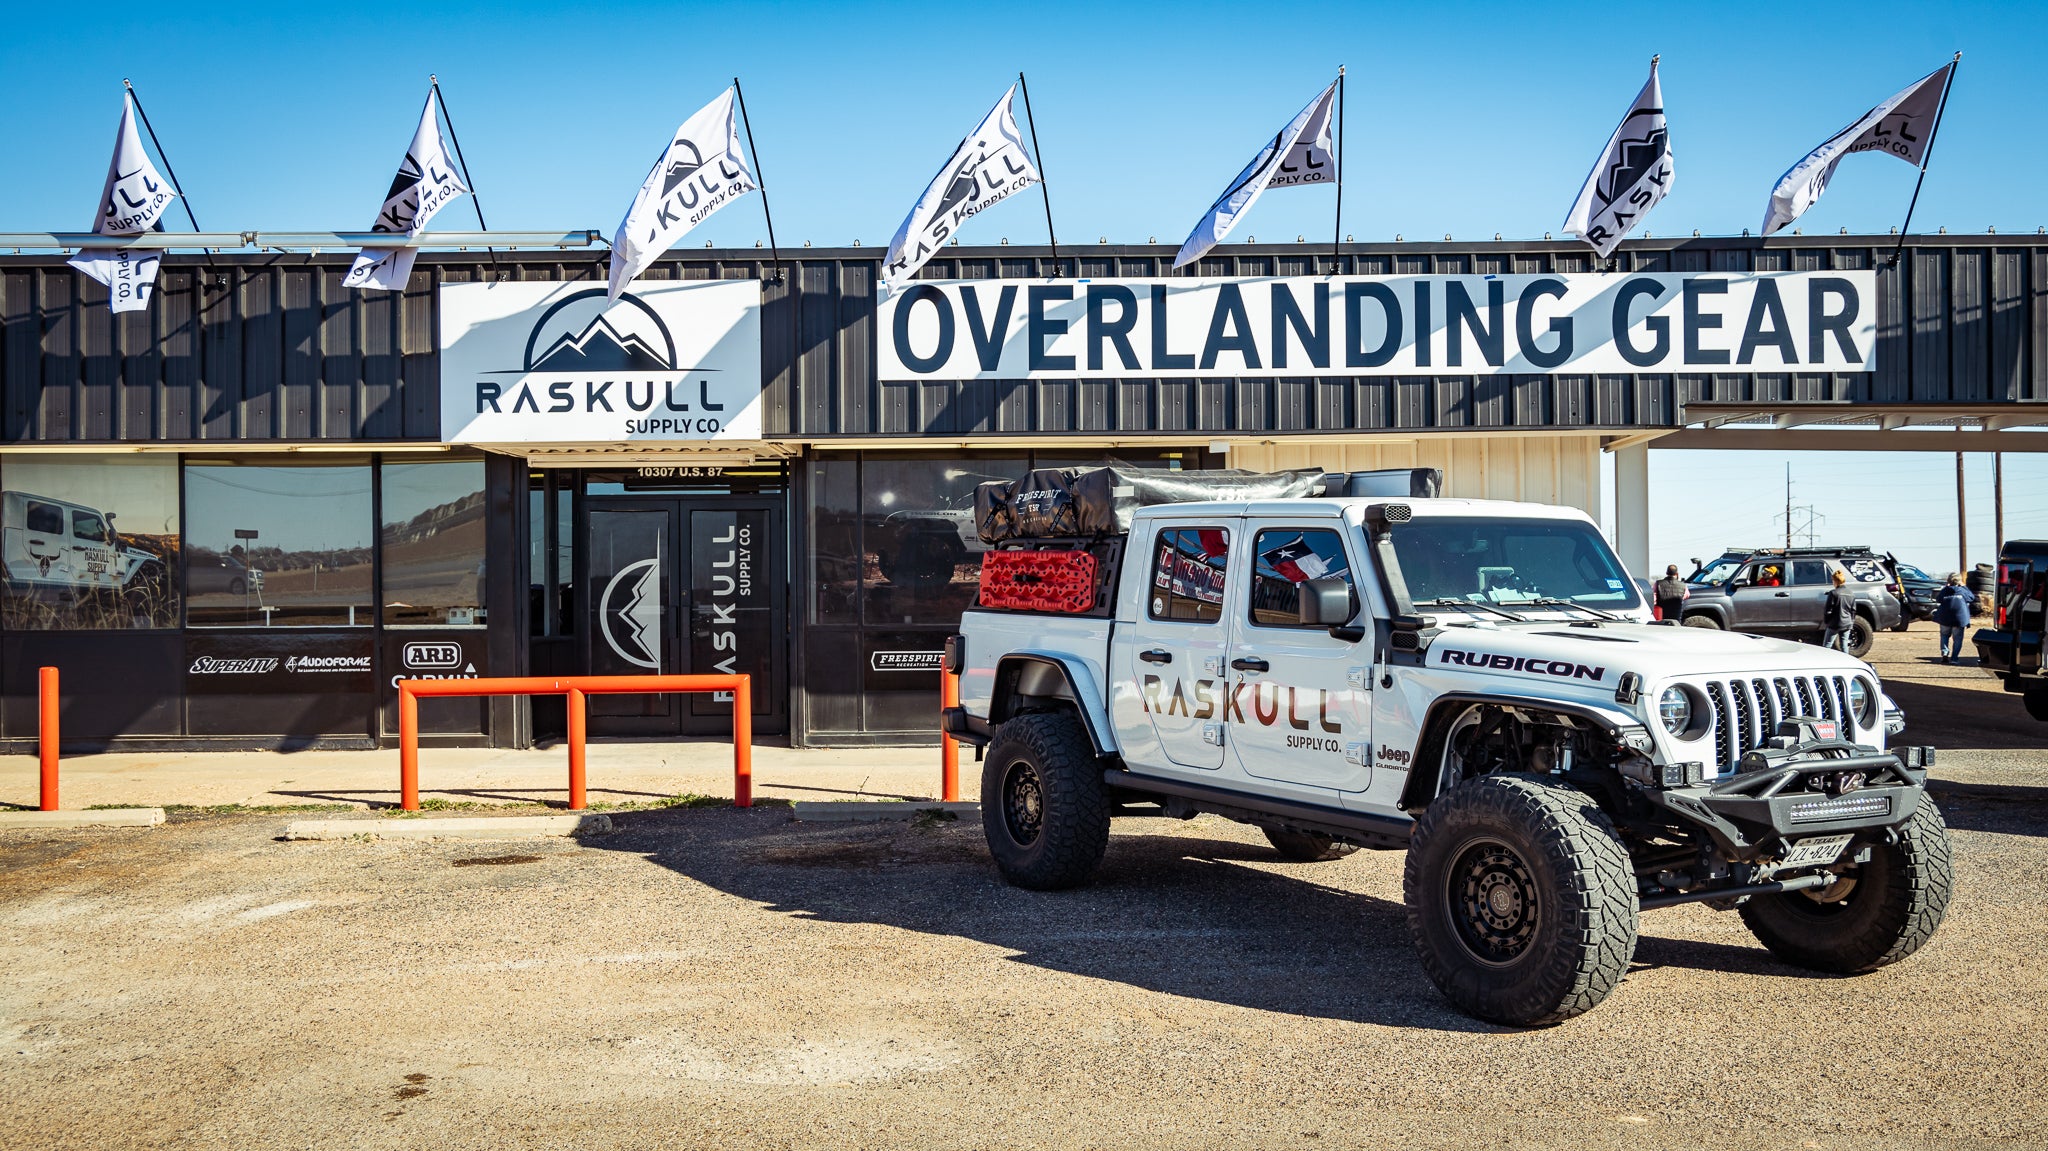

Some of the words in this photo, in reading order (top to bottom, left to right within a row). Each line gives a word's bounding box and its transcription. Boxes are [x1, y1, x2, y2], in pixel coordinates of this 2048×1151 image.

[1892, 141, 1912, 158] CO.
[1012, 176, 1031, 191] CO.
[1303, 173, 1325, 182] CO.
[107, 206, 153, 231] SUPPLY
[153, 193, 167, 209] CO.
[690, 192, 725, 226] SUPPLY
[728, 181, 747, 198] CO.
[893, 278, 1573, 374] OVERLANDING
[1612, 277, 1863, 367] GEAR
[476, 380, 724, 413] RASKULL
[625, 418, 692, 434] SUPPLY
[696, 418, 725, 434] CO.
[638, 467, 675, 477] 10307
[680, 467, 704, 477] U.S.
[708, 467, 723, 477] 87
[739, 523, 751, 546] CO.
[739, 548, 751, 596] SUPPLY
[411, 648, 456, 663] ARB
[1440, 649, 1605, 681] RUBICON
[1144, 674, 1342, 734] RASKULL
[1286, 735, 1323, 751] SUPPLY
[1324, 739, 1342, 753] CO.
[1377, 744, 1410, 765] Jeep
